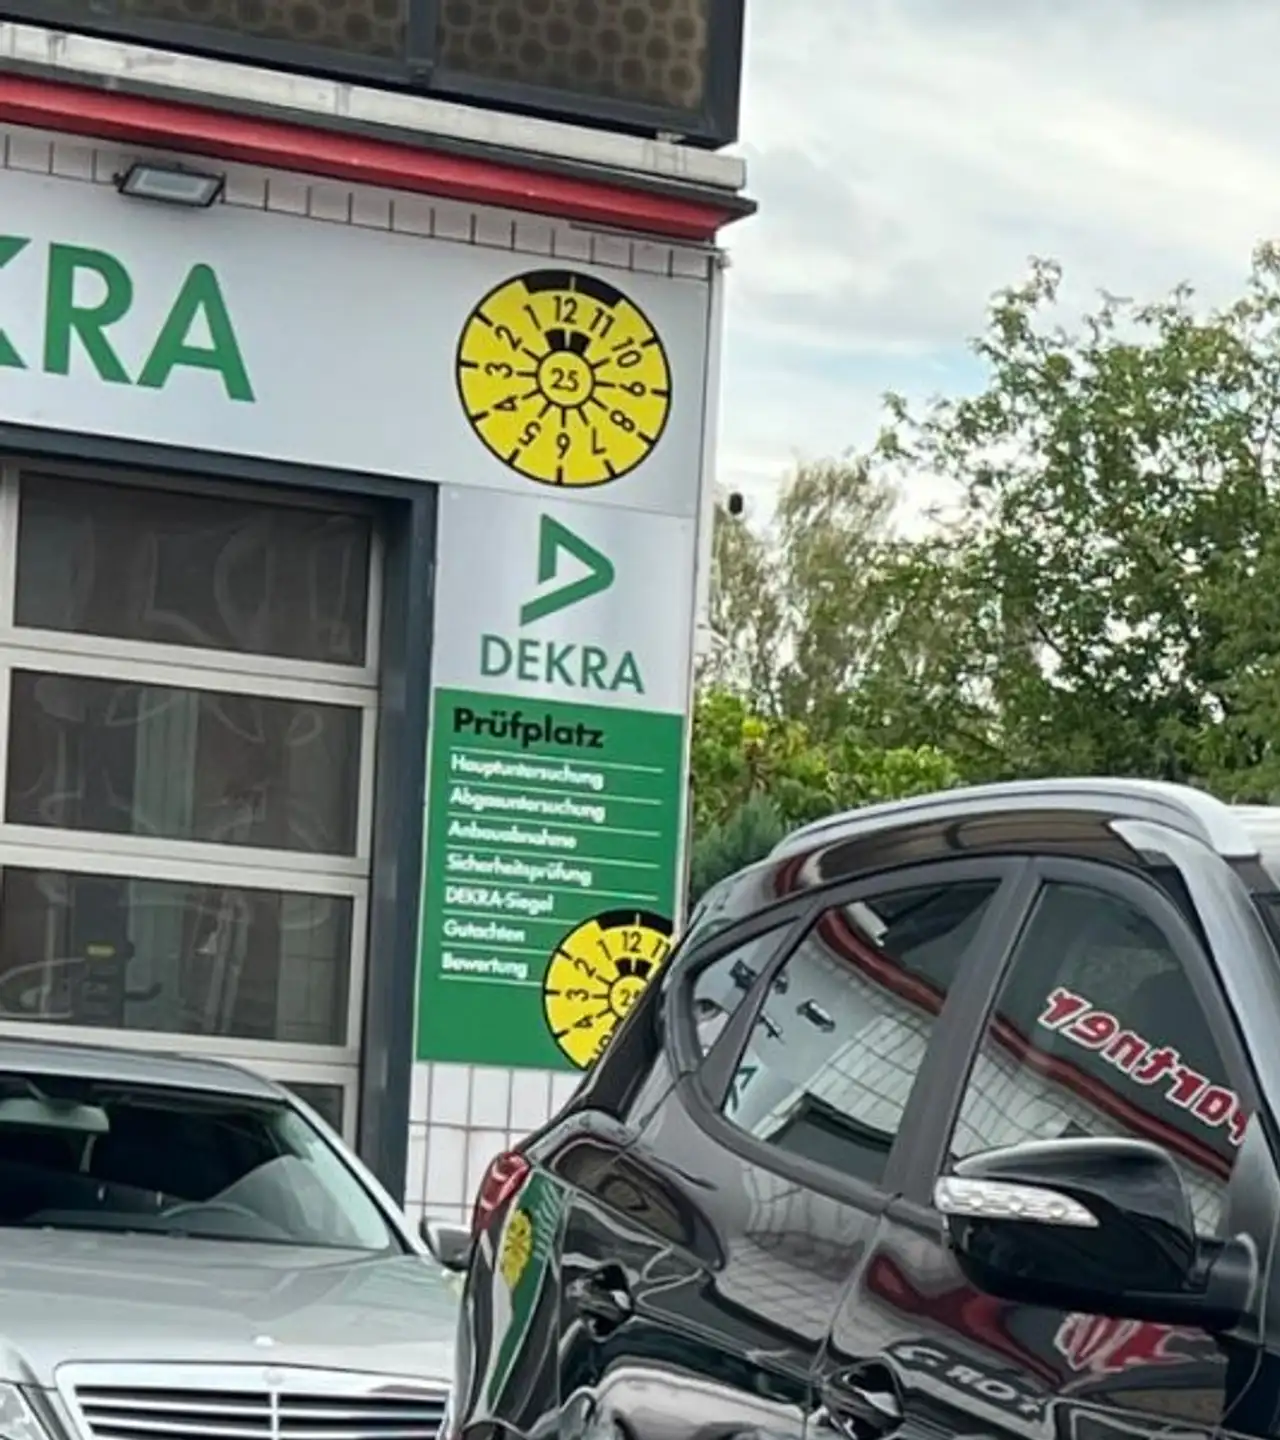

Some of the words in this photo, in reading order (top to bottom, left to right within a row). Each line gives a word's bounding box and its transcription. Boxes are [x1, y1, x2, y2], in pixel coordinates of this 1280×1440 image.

[523, 303, 541, 330] 1
[553, 295, 578, 324] 12
[589, 307, 615, 339] 11
[494, 325, 523, 352] 2
[611, 336, 642, 369] 10
[484, 361, 513, 380] 3
[550, 367, 580, 393] 25
[619, 381, 646, 397] 9
[492, 395, 518, 412] 4
[518, 421, 542, 446] 5
[609, 409, 636, 433] 8
[556, 432, 571, 459] 6
[591, 427, 607, 455] 7
[480, 633, 645, 695] DEKRA
[453, 706, 604, 749] Prüfplatz
[451, 753, 604, 790] Hauptuntersuchung
[450, 787, 606, 824] Abgasuntersuchung
[446, 853, 592, 887] Sicherheitsprüfung
[445, 886, 554, 916] DEKRA-Siegel
[442, 919, 526, 943] Gutachten
[621, 931, 642, 953] 12
[596, 940, 613, 961] 1
[441, 952, 529, 980] Bewertung
[573, 957, 597, 978] 2
[565, 988, 590, 1002] 3
[572, 1014, 594, 1029] 4
